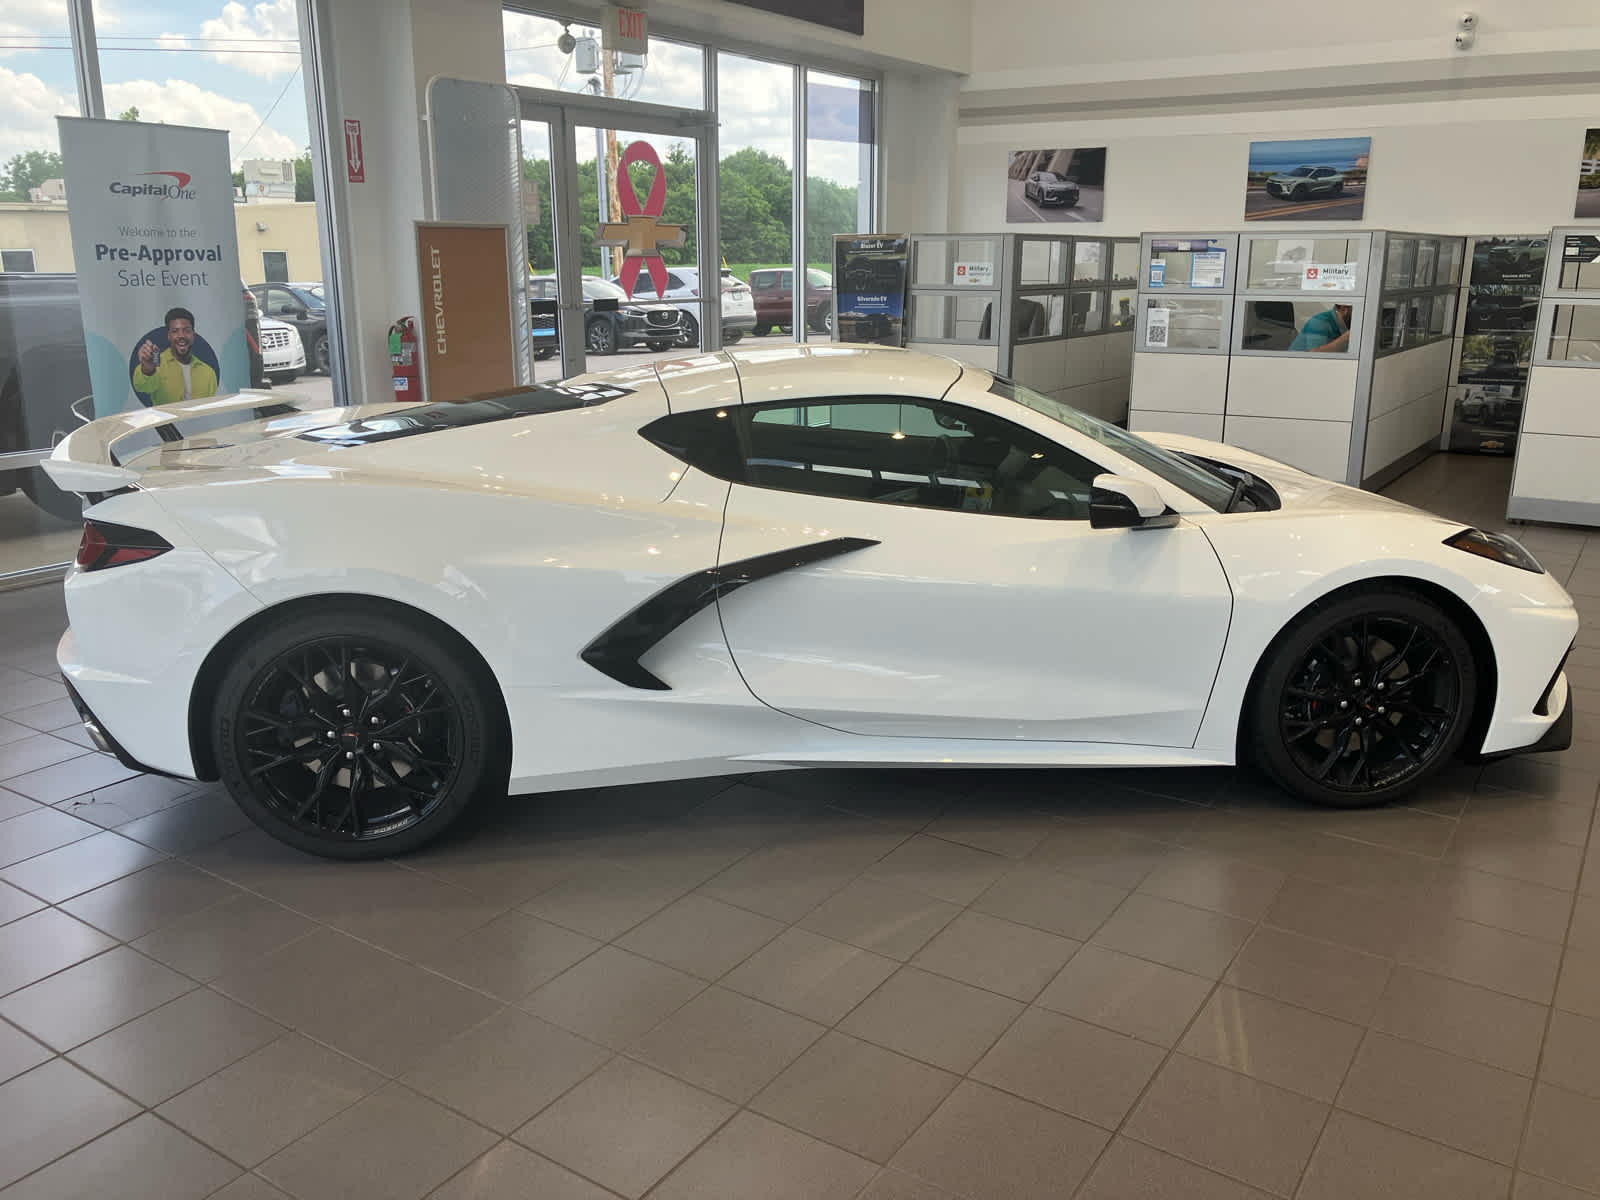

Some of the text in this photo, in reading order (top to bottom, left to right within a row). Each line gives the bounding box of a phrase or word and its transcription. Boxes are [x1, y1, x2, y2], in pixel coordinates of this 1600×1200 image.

[618, 8, 643, 40] EXIT
[119, 226, 197, 238] Welcome to the
[95, 243, 222, 266] Pre-Approval
[118, 269, 209, 287] Sale Event
[431, 246, 447, 354] CHEVROLET
